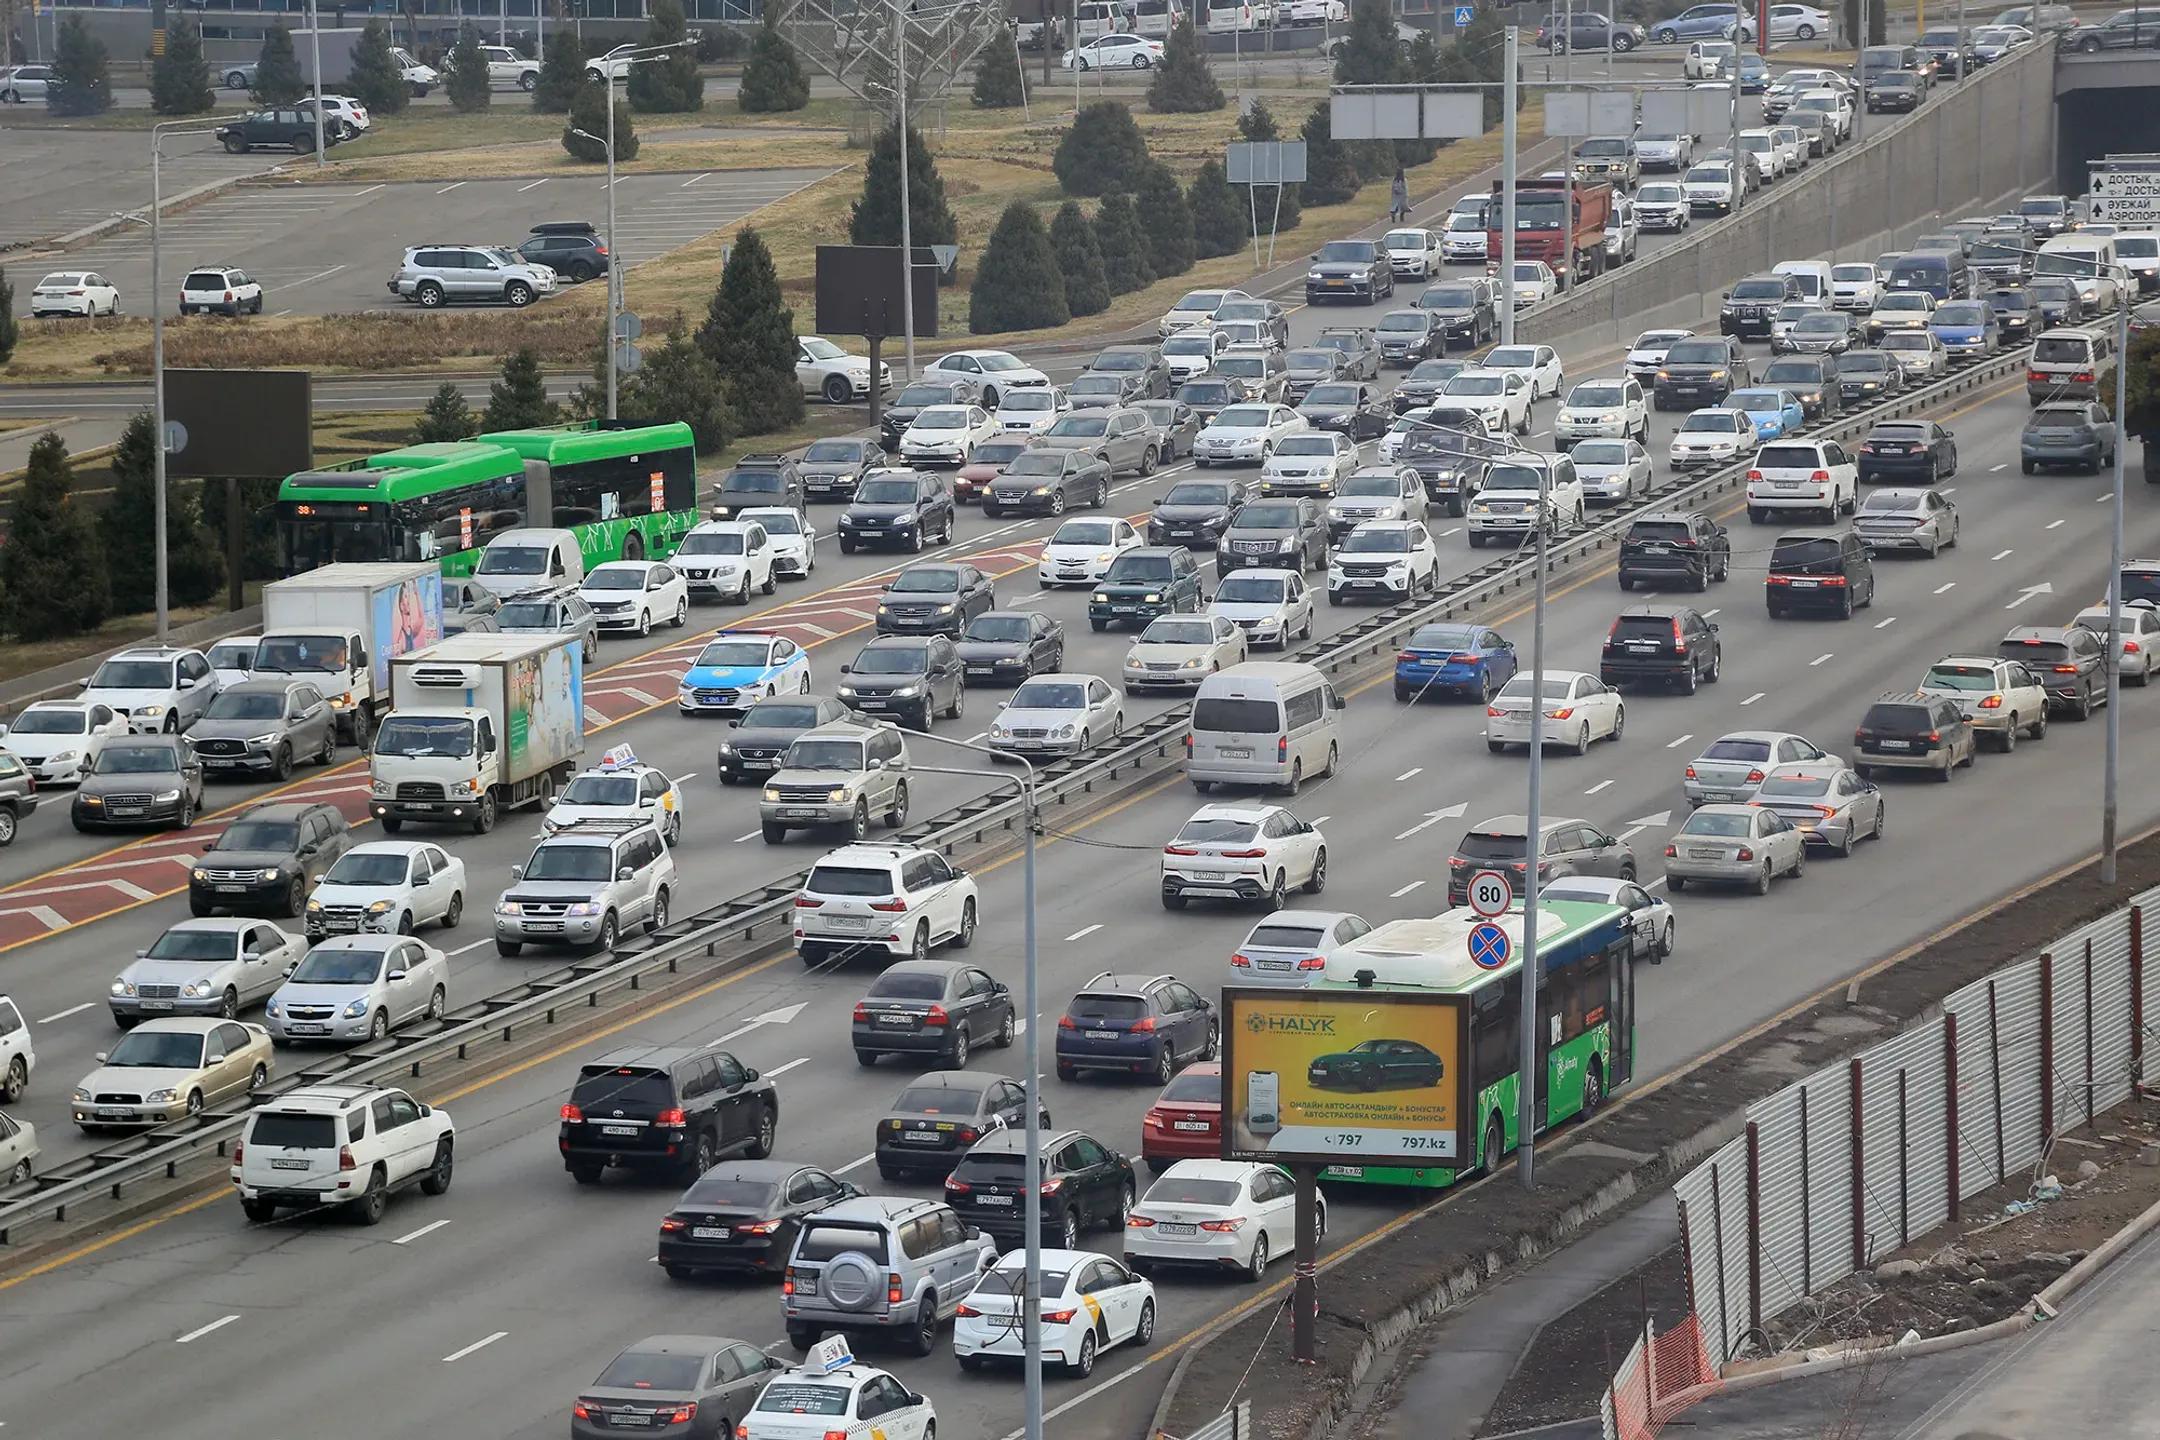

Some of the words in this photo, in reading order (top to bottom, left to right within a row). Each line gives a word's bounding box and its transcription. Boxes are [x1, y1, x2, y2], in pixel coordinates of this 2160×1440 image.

[2107, 198, 2151, 209] ӘУЕЖАЙ
[1479, 885, 1501, 904] 80
[1269, 1017, 1335, 1032] HALYK
[1289, 1101, 1323, 1109] ОНЛАЙН
[1303, 1111, 1369, 1120] АВТОСТРАХОВКА
[1370, 1112, 1405, 1121] ОНЛАЙН
[1412, 1114, 1446, 1122] БОНУСЫ
[1338, 1134, 1362, 1146] 797
[1402, 1136, 1446, 1149] 797.kz
